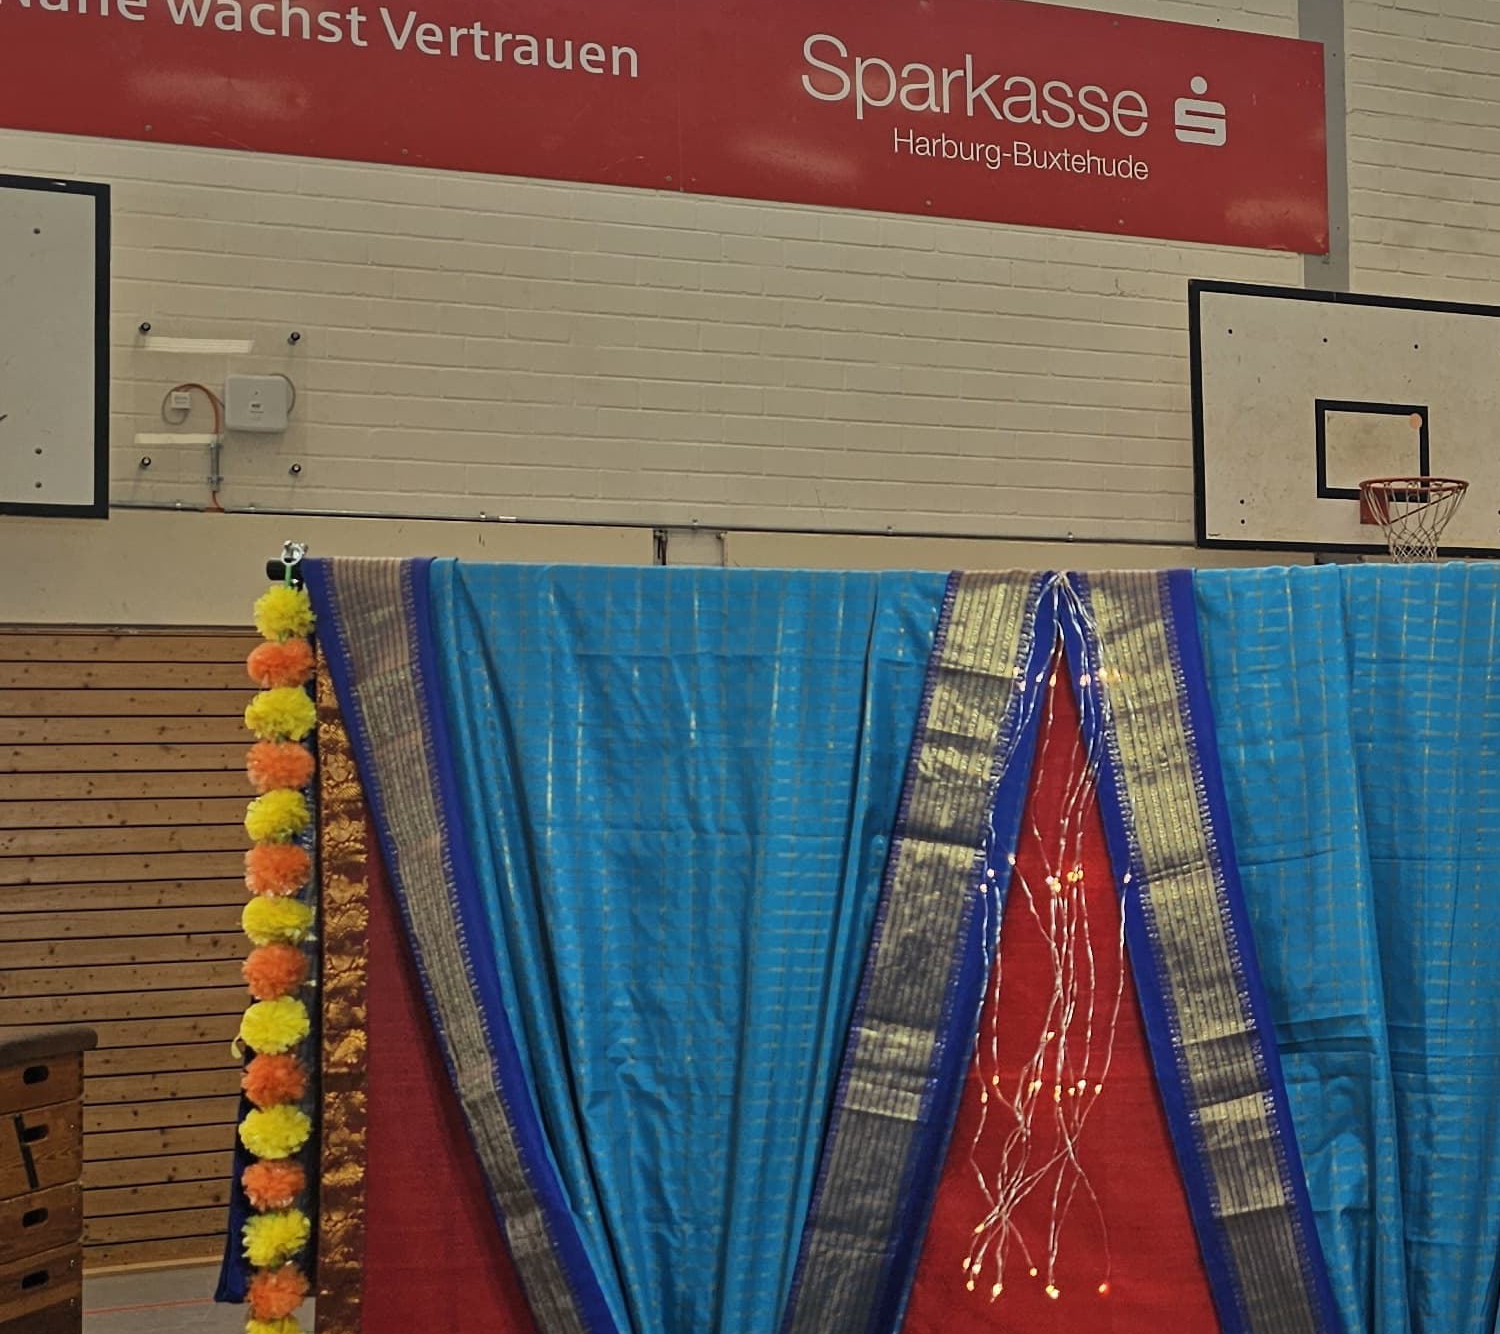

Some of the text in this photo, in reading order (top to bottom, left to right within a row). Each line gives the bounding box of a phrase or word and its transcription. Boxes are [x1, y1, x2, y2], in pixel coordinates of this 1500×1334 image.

[379, 7, 638, 78] Vertrauen
[801, 33, 1149, 137] Sparkasse
[893, 127, 1149, 180] Harburg-Buxtehude
